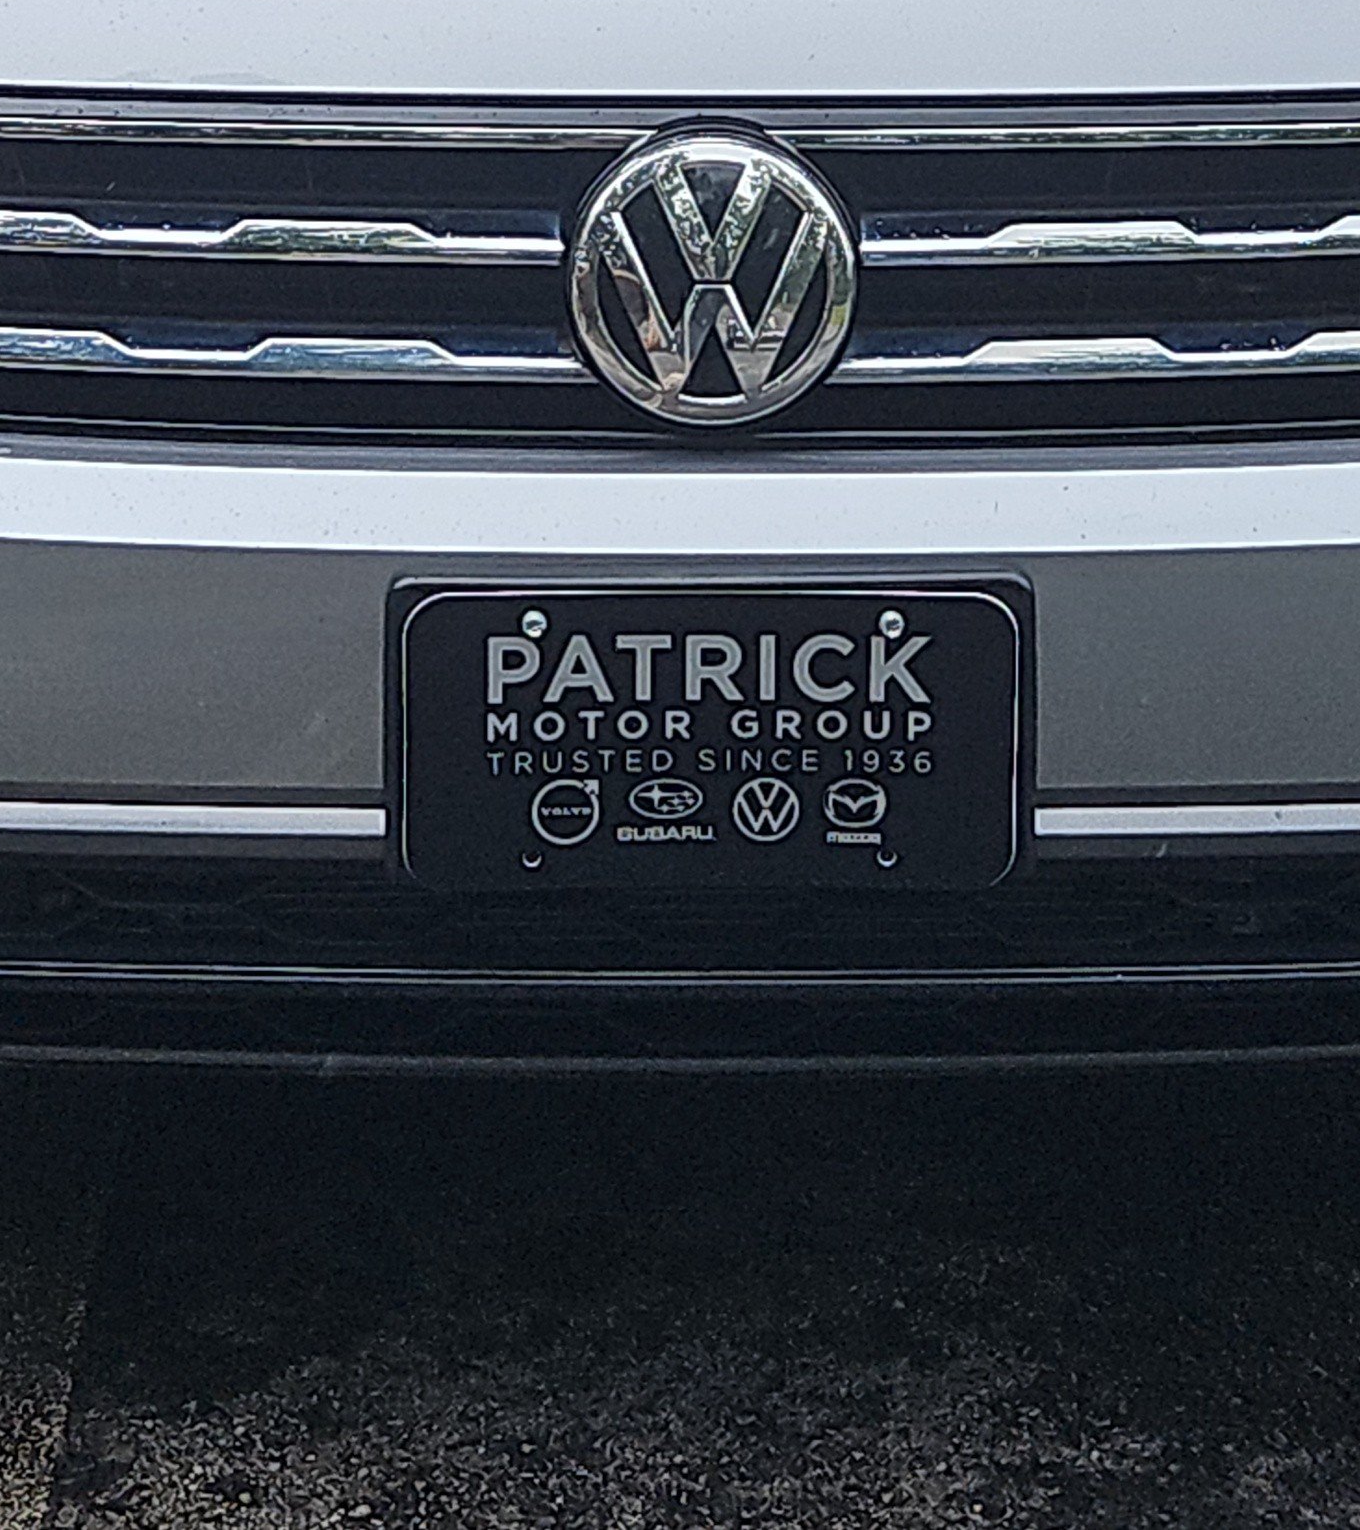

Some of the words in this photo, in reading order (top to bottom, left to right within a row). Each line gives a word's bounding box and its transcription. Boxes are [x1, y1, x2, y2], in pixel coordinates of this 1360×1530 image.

[486, 635, 932, 705] PATRICK
[486, 709, 692, 743] MOTOR
[730, 708, 932, 741] GROUP
[486, 748, 674, 775] TRUSTED
[697, 748, 820, 772] SINCE
[844, 749, 932, 774] 1936
[615, 825, 713, 842] SUBARU
